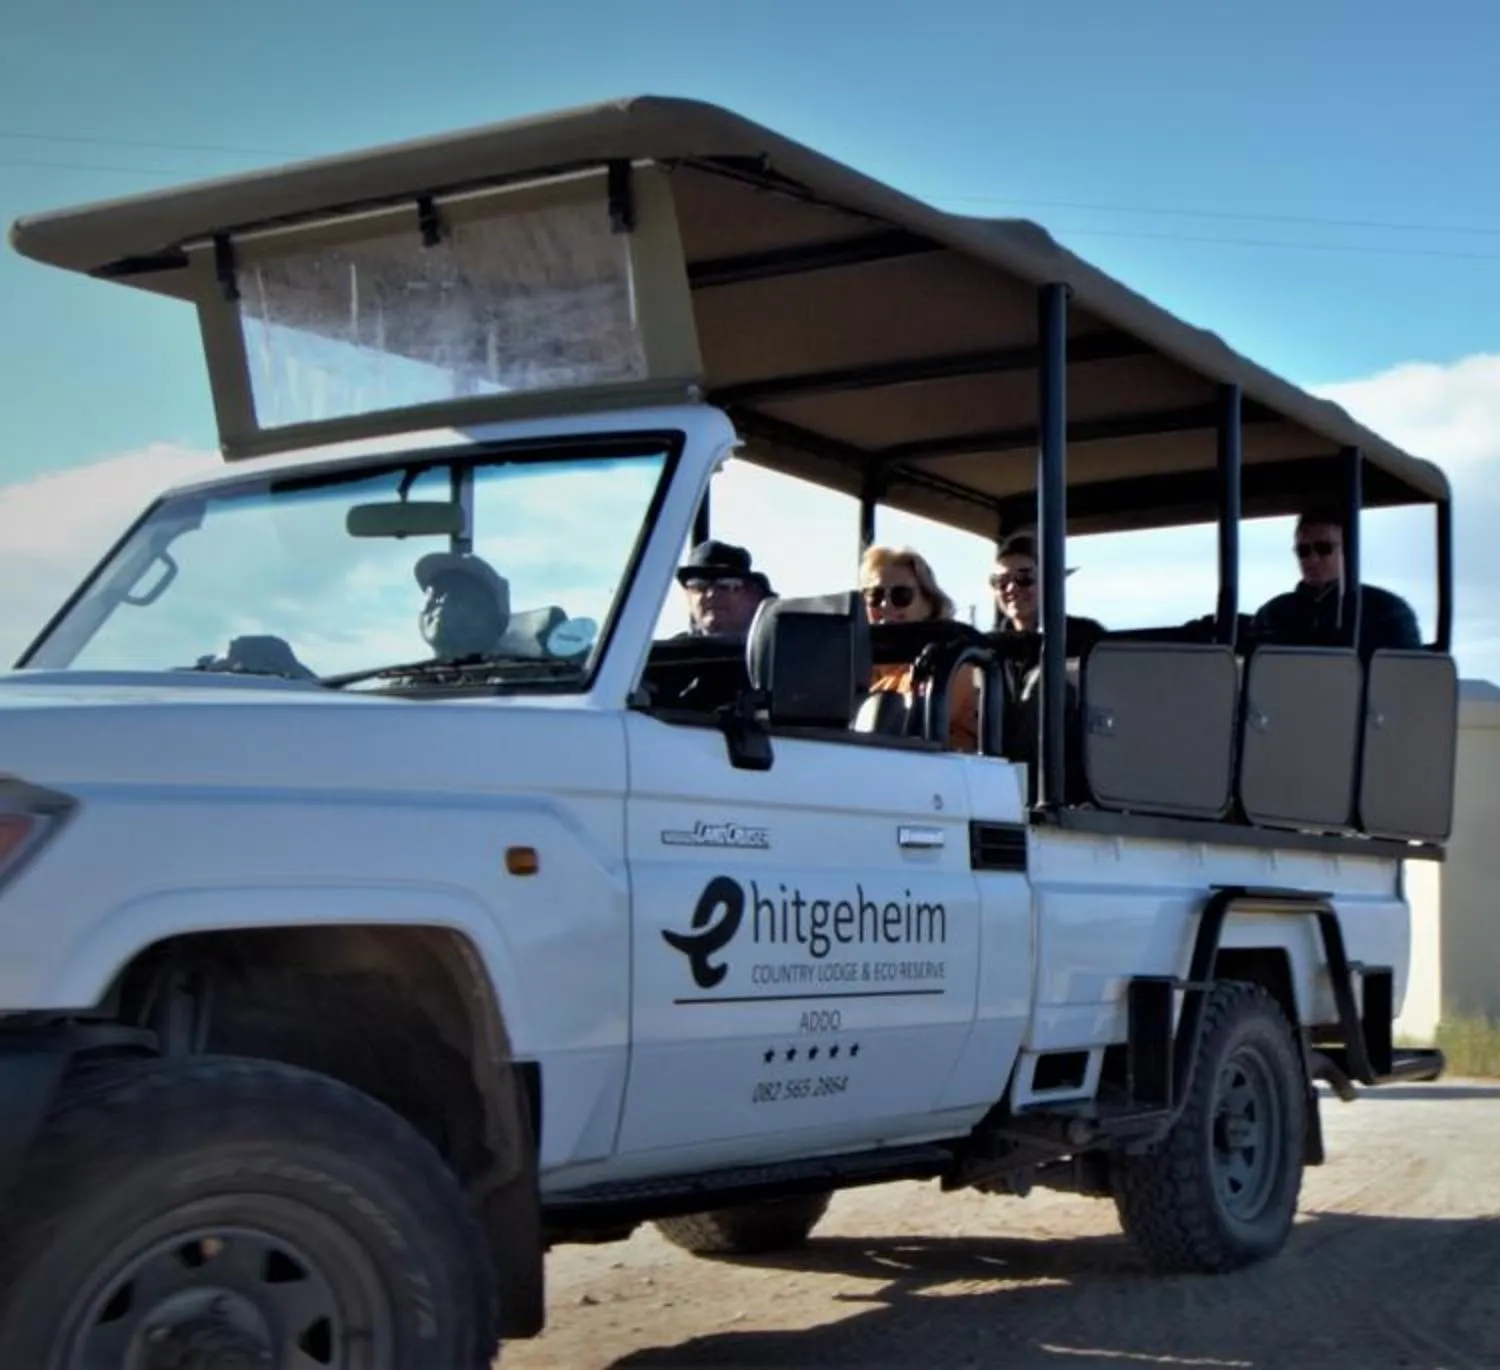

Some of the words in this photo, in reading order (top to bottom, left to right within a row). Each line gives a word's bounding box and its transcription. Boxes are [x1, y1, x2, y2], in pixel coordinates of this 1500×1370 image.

[751, 878, 947, 958] hitgeheim
[752, 963, 815, 985] COUNTRY
[817, 962, 859, 983] LODGE
[861, 962, 871, 982] &
[873, 961, 898, 982] ECO
[898, 959, 946, 980] RESERVE
[800, 1009, 842, 1032] ADDO
